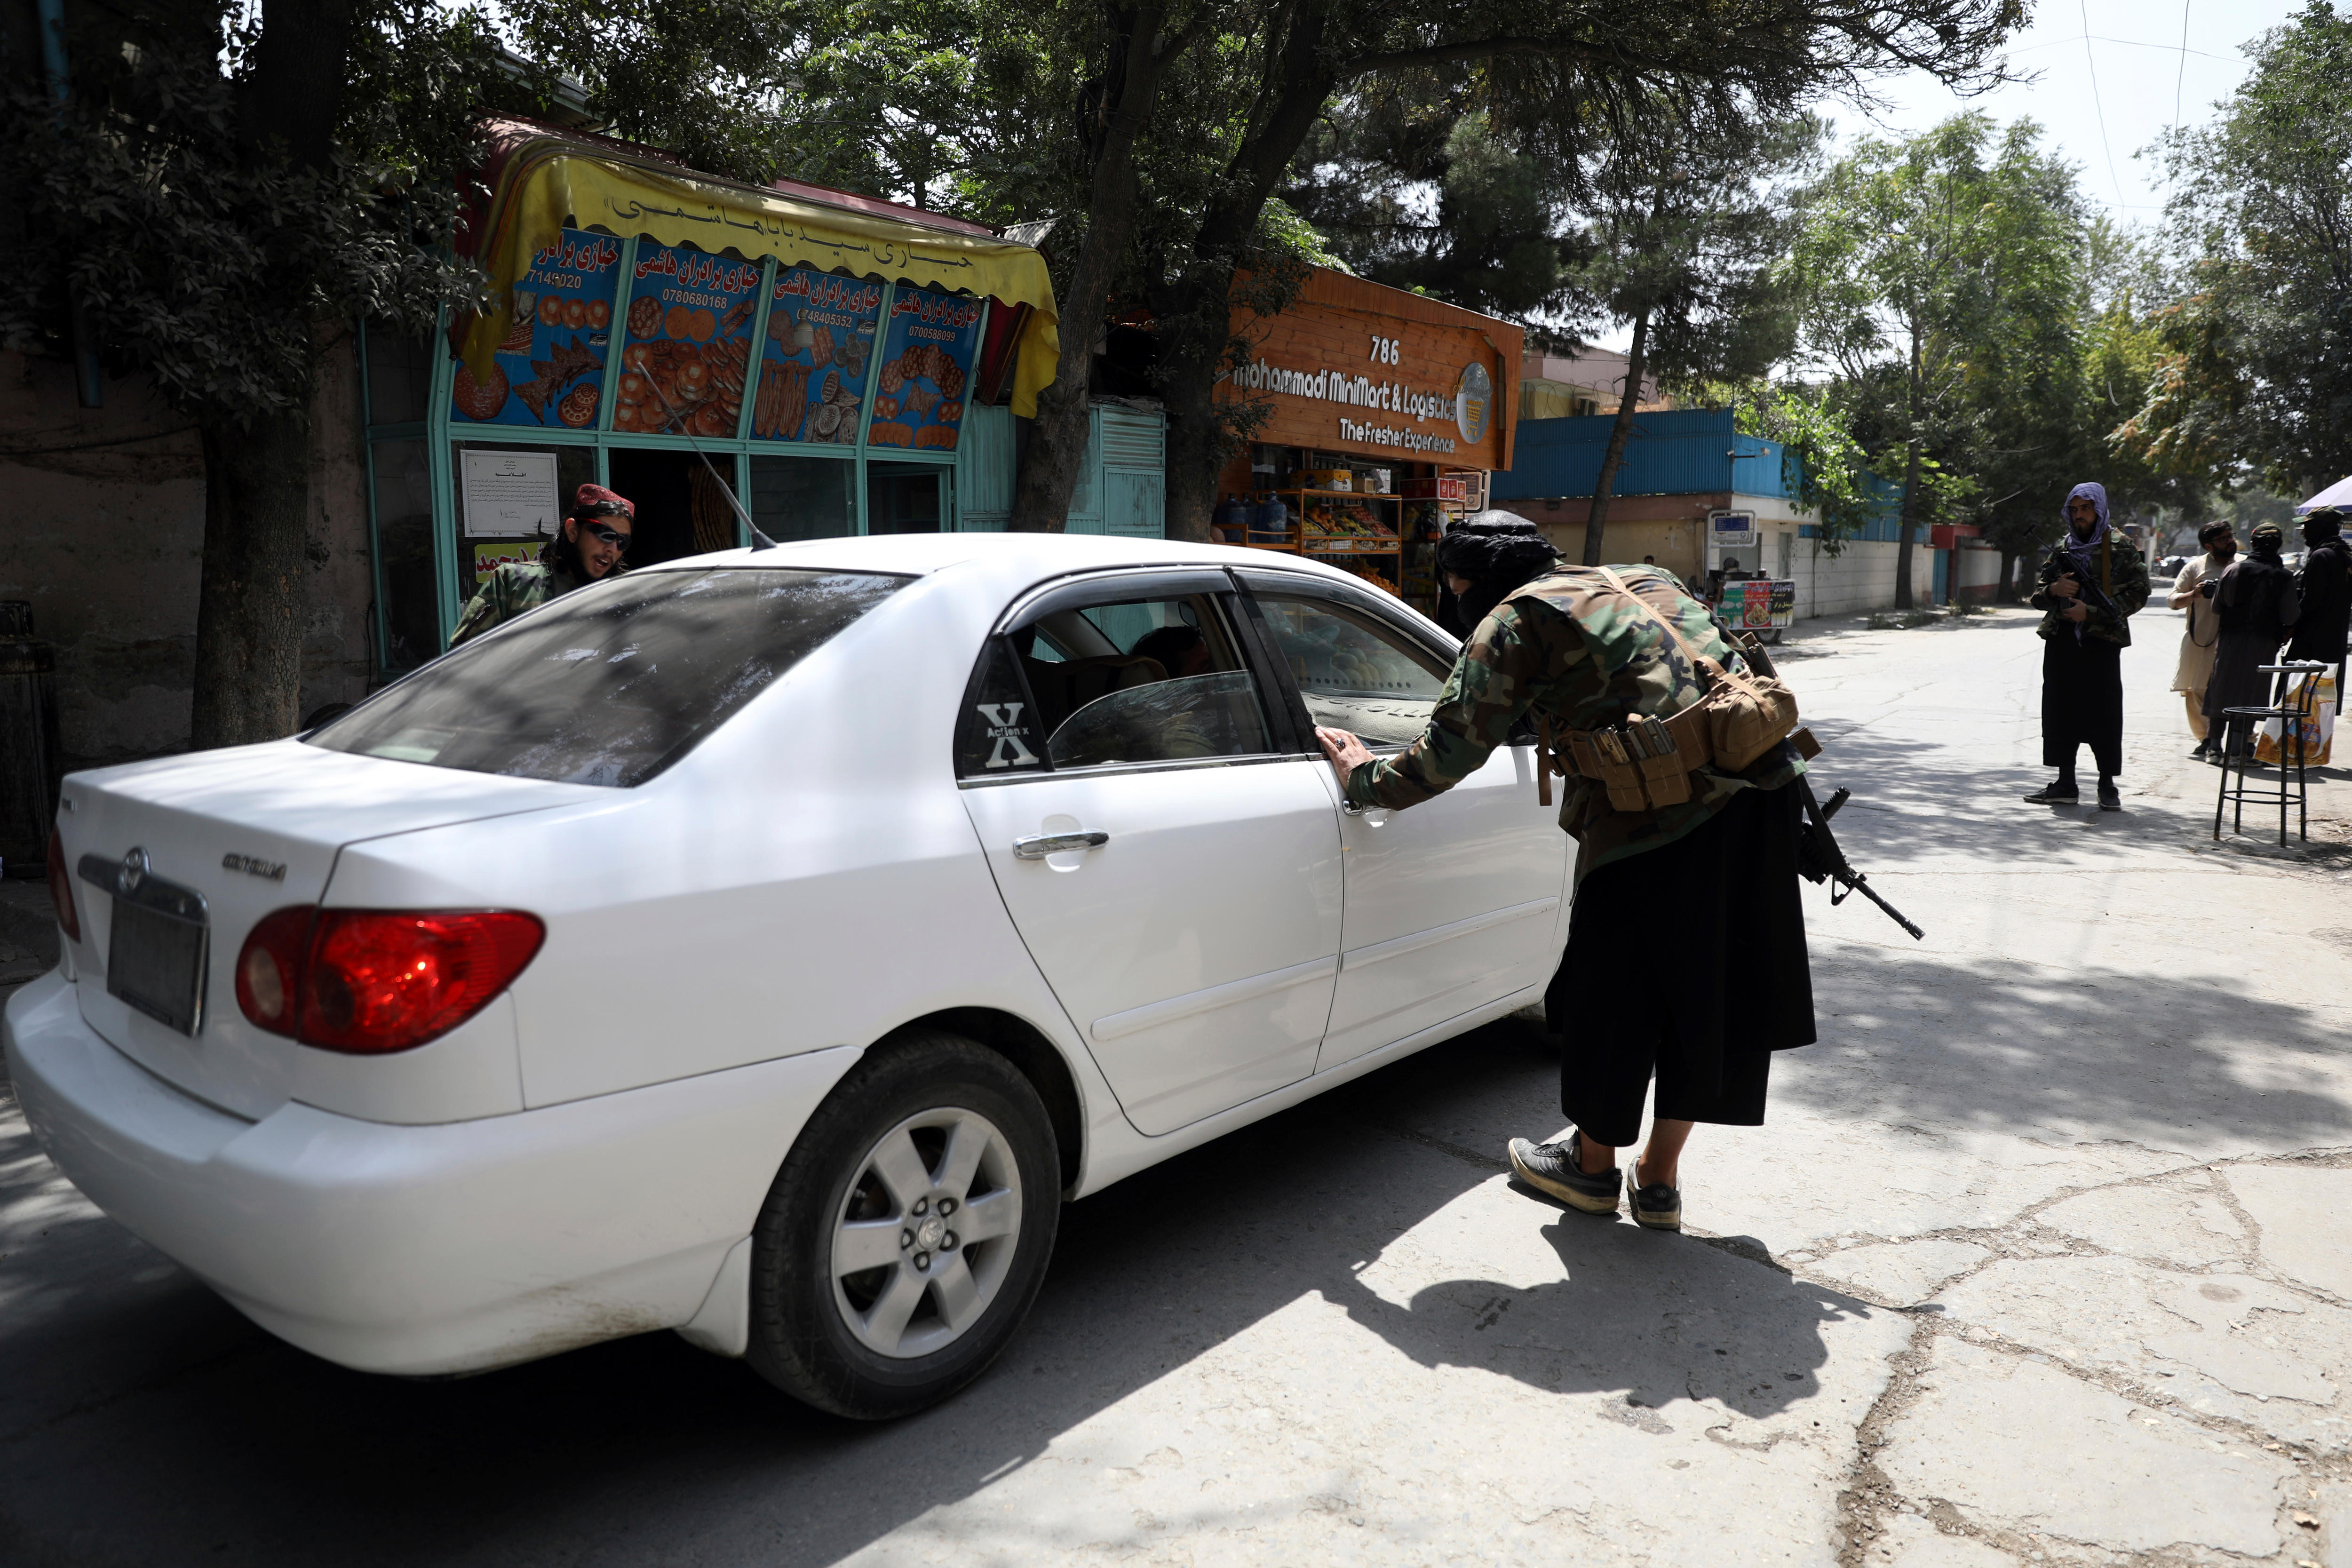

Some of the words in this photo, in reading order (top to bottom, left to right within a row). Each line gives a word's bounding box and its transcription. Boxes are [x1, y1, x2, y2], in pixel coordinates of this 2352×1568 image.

[575, 238, 618, 273] خبازی
[635, 249, 677, 279] هاشمی
[678, 254, 723, 290] برادران
[723, 263, 759, 294] خبازی
[773, 272, 810, 299] هاشمی
[662, 288, 728, 309] 0780680168
[810, 277, 849, 310] برادران
[848, 285, 880, 314] خبازی
[890, 292, 921, 318] هاشمی
[921, 295, 954, 325] برادران
[909, 326, 955, 342] 0700588099
[1370, 335, 1400, 366] 786
[1329, 371, 1390, 410] MiniMart
[1392, 383, 1401, 413] &
[1403, 385, 1457, 422] Logistics
[1339, 418, 1364, 441] The
[1365, 422, 1404, 446] Fresher
[1404, 427, 1455, 454] Experience
